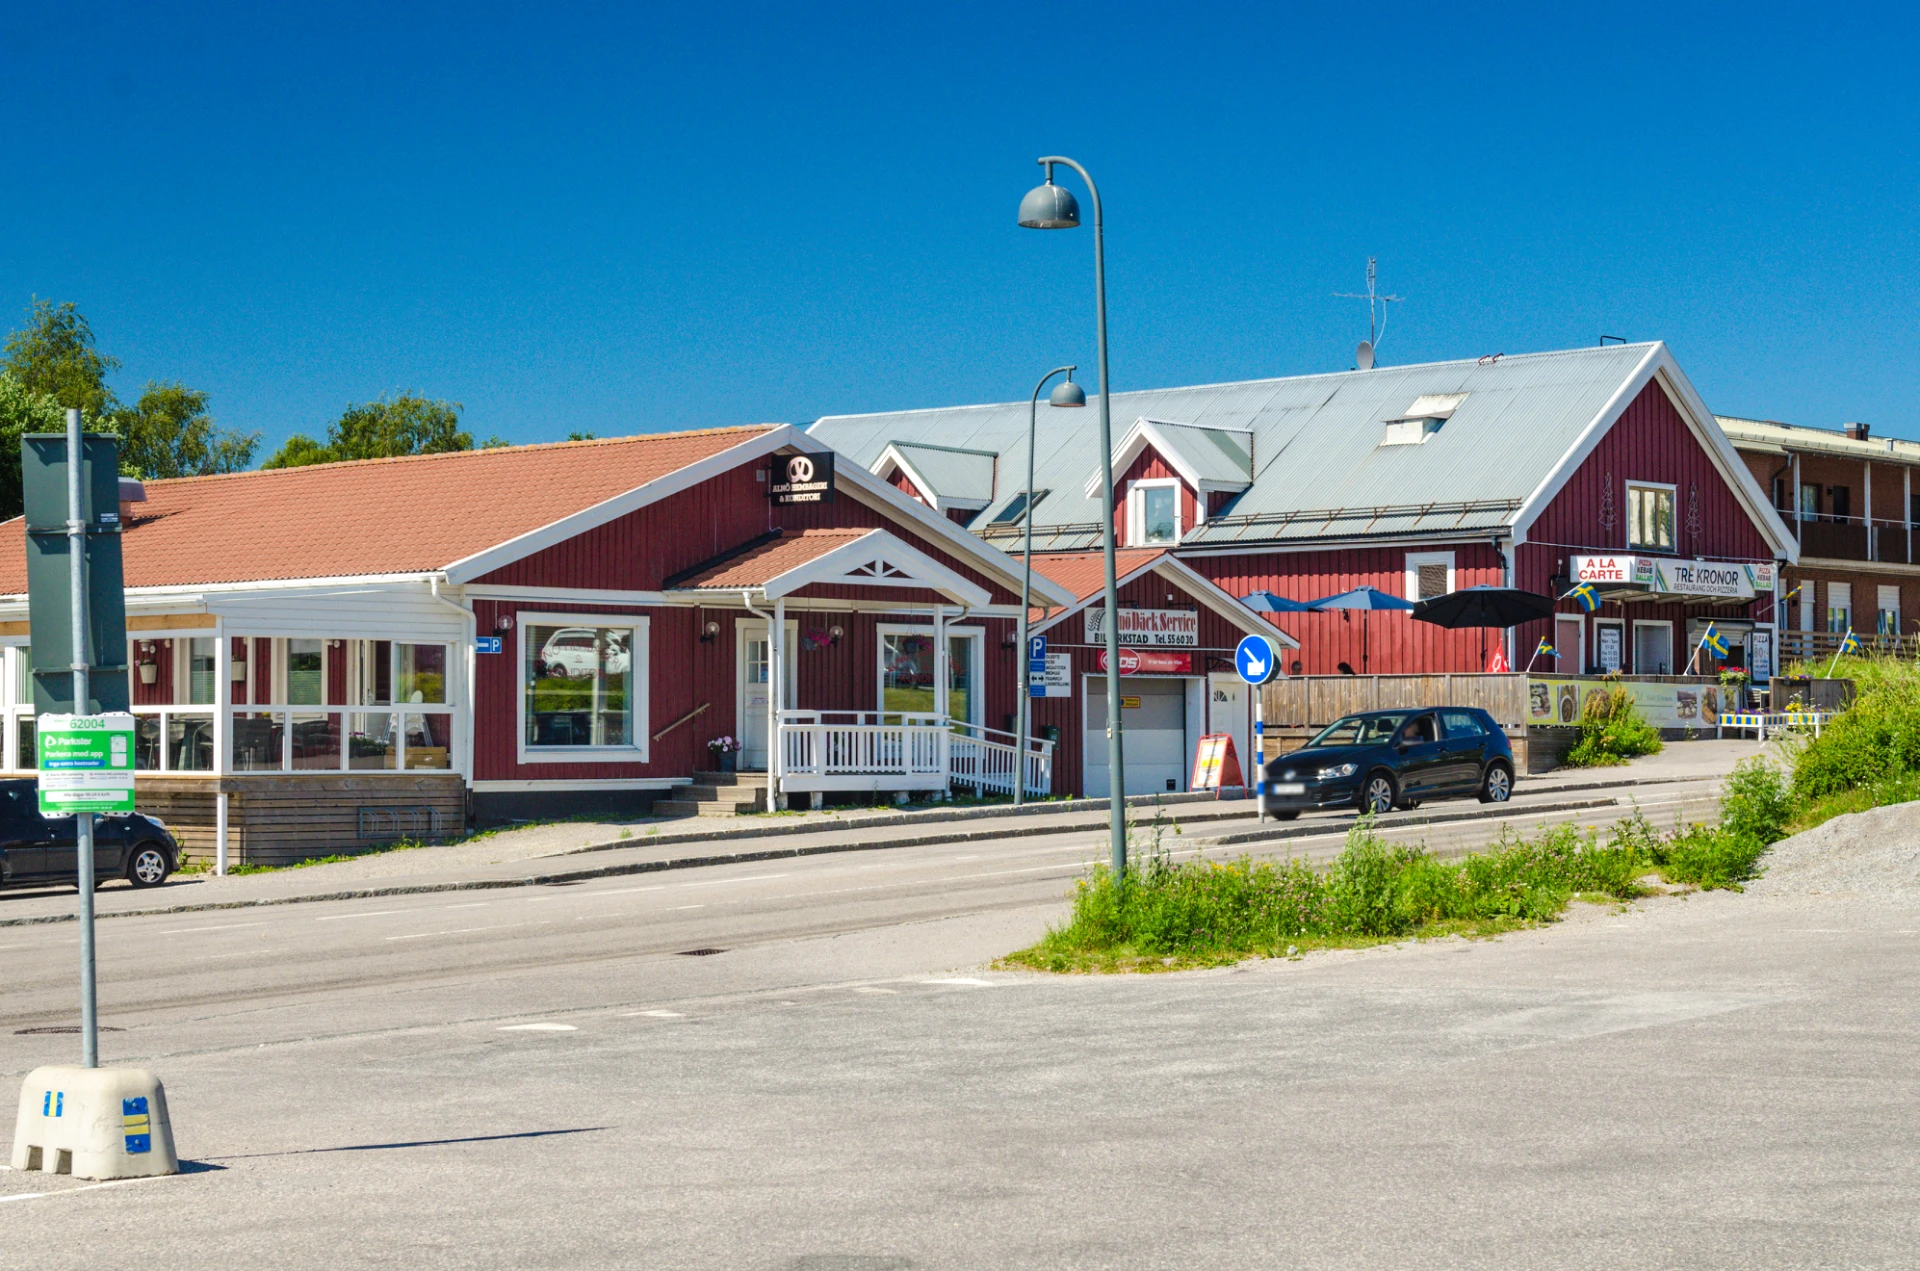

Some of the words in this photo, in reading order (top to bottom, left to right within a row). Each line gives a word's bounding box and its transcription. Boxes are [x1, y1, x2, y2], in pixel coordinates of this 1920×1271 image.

[772, 482, 790, 492] ALNÖ
[1586, 558, 1595, 568] A
[1599, 558, 1616, 568] LA
[1579, 570, 1623, 580] CARTE
[1675, 567, 1694, 582] TRE
[1696, 569, 1738, 586] KRONOR
[1674, 583, 1705, 592] RESTAURANG
[1717, 586, 1738, 594] PIZZERIA
[1132, 612, 1159, 631] Däck
[1160, 612, 1196, 632] Service
[1095, 633, 1148, 643] BILRKSTAD
[1154, 634, 1166, 644] Tel.
[492, 640, 500, 650] P
[1033, 639, 1042, 657] P
[70, 719, 105, 728] 62004
